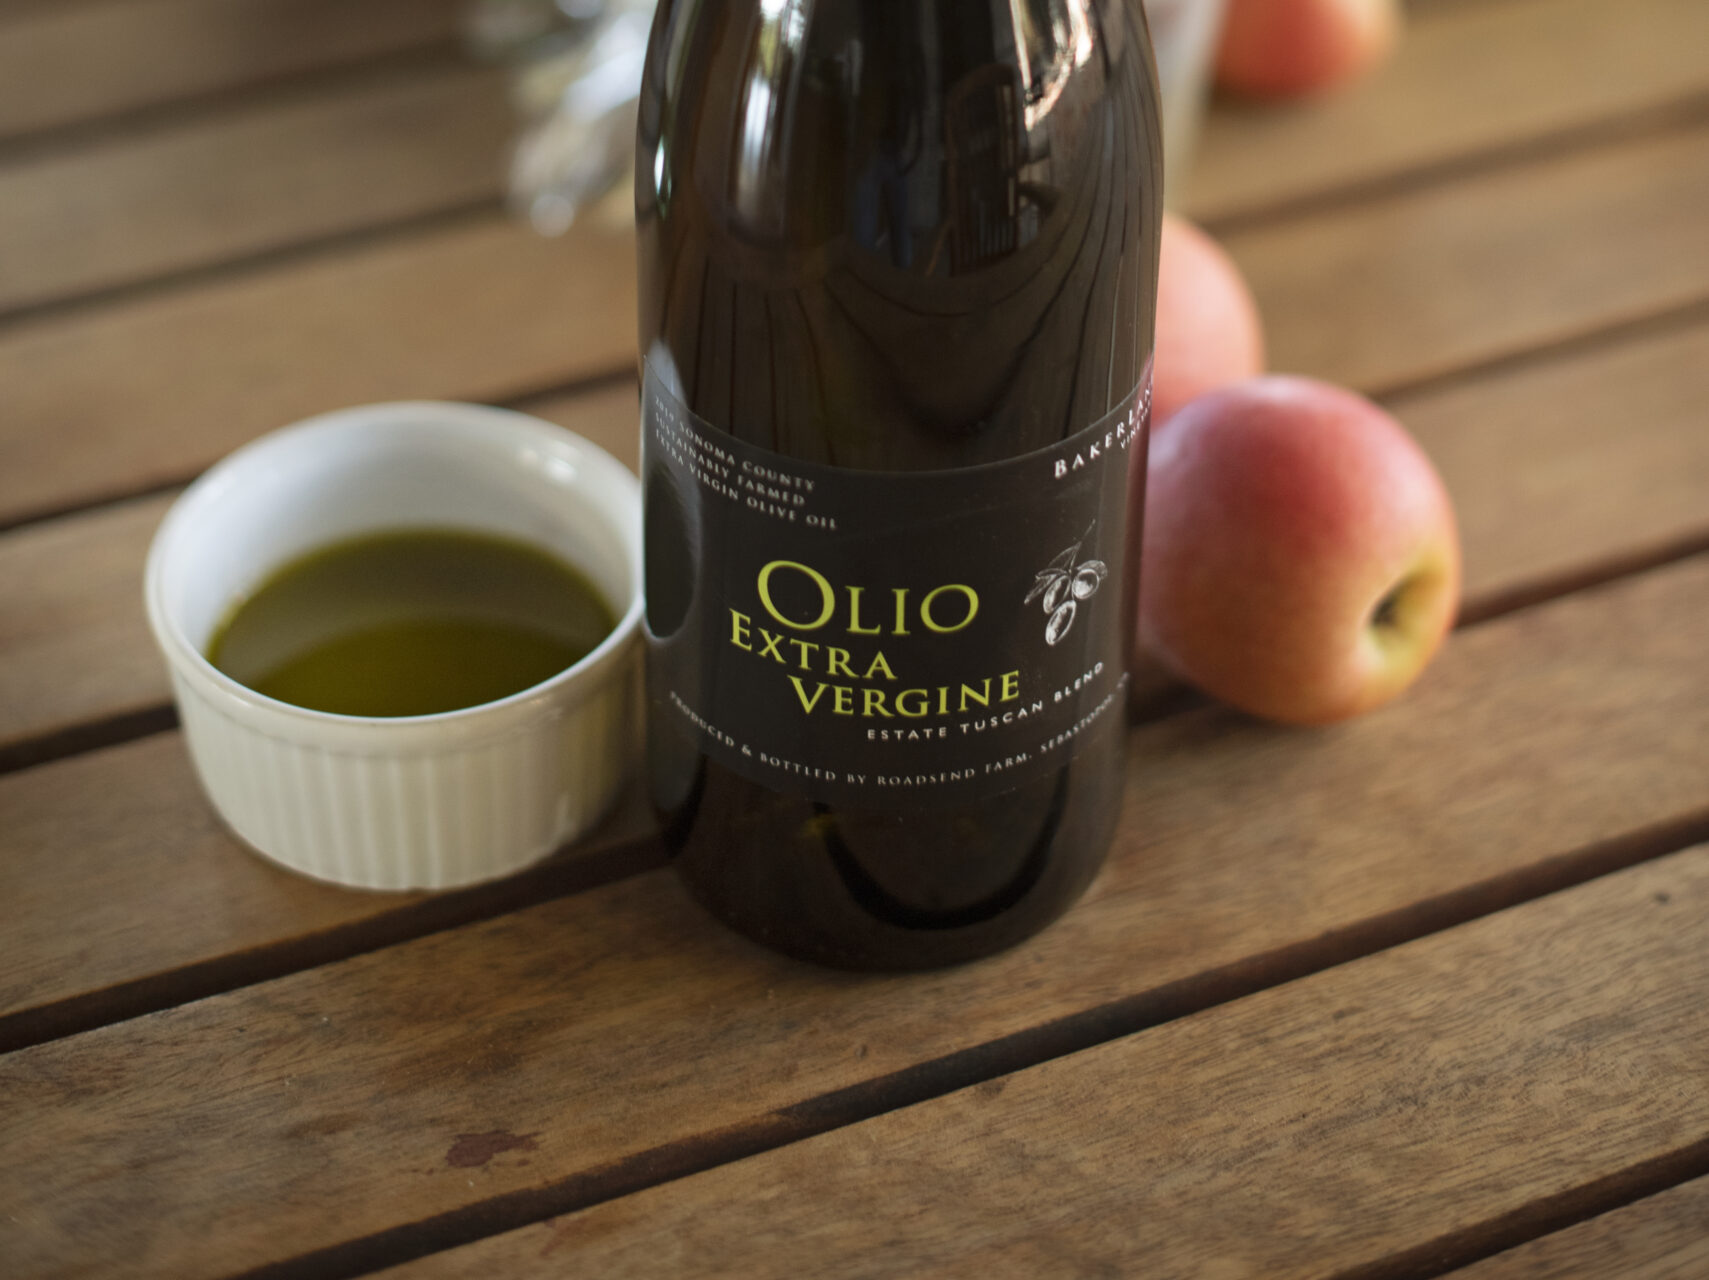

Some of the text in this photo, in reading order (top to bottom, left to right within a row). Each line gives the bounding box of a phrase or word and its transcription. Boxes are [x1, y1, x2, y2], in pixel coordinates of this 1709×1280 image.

[655, 412, 806, 505] SUSTAINABLY FARMED
[655, 430, 838, 531] EXTRA VIRGIN OLIVE OIL
[679, 422, 736, 466] SONOMA
[742, 460, 816, 491] COUNTY
[756, 559, 980, 636] OLIO
[729, 608, 898, 681] EXTRA
[787, 669, 1020, 718] VERGINE
[867, 727, 948, 741] ESTATE
[959, 699, 1044, 734] TUSCAN
[1053, 661, 1105, 703] BLEND
[669, 690, 736, 748] PRODUCED
[741, 744, 753, 757] &
[760, 752, 836, 782] BOTTLED
[847, 773, 866, 786] BY
[877, 767, 976, 787] ROADSEND
